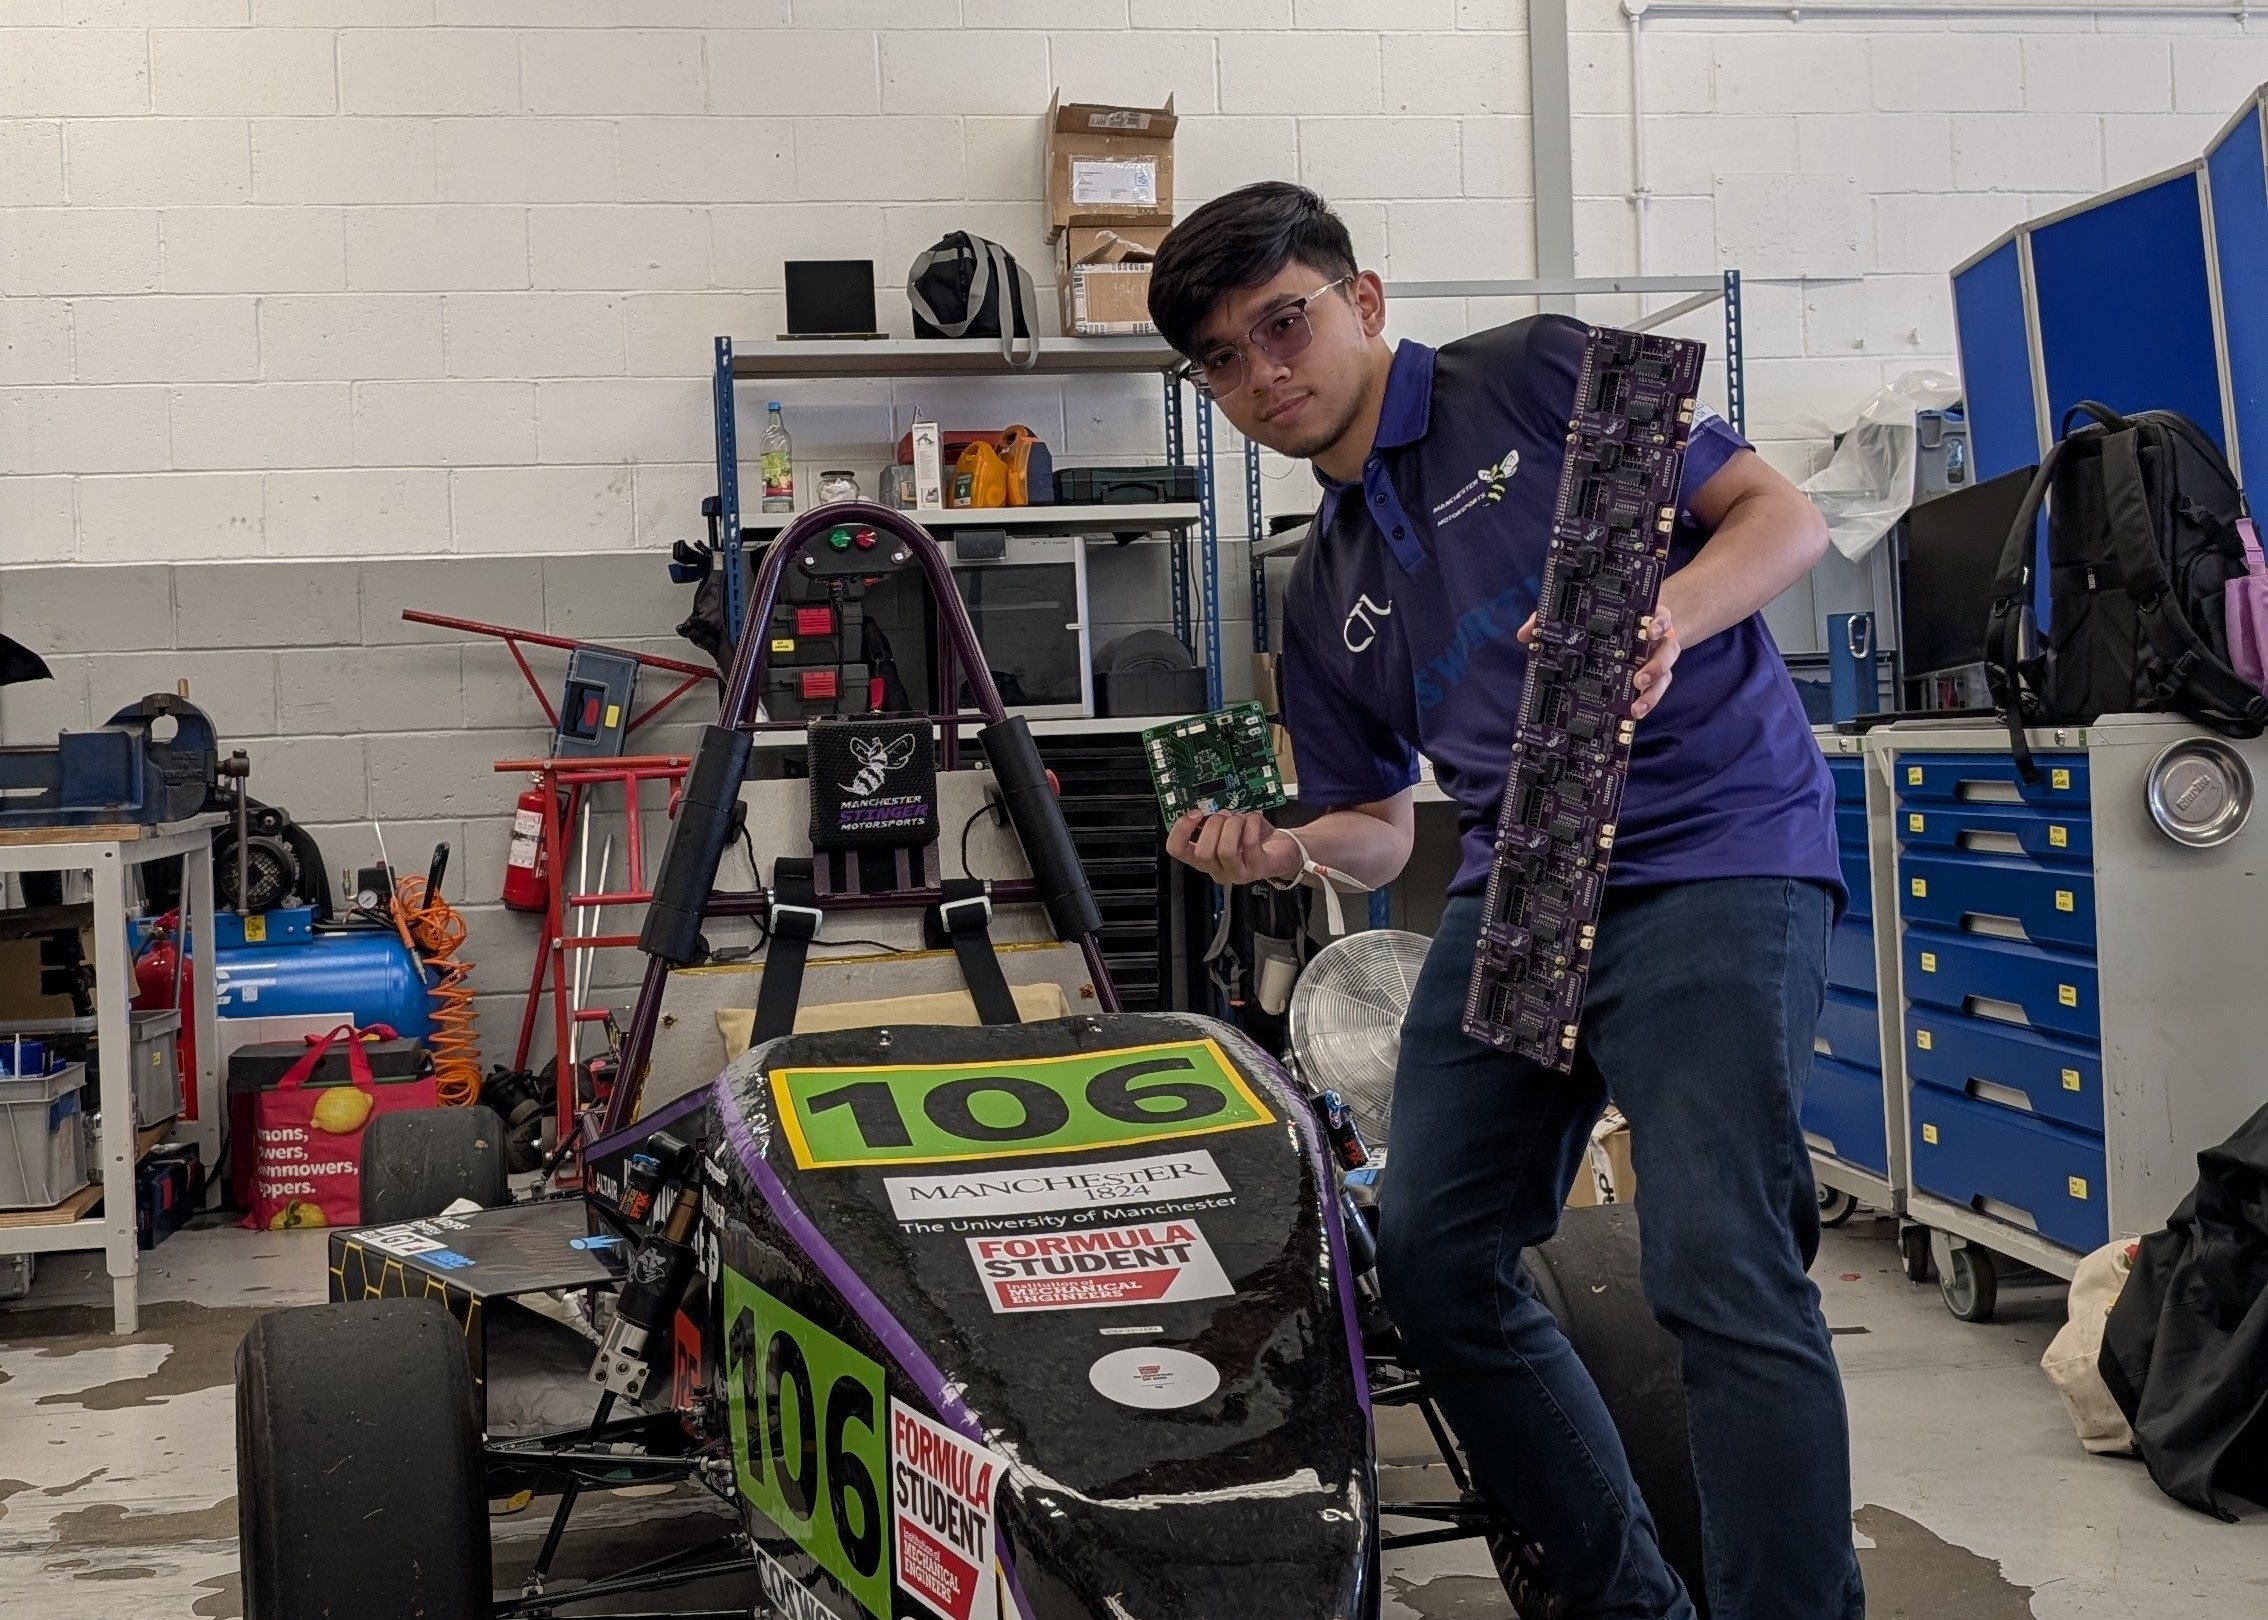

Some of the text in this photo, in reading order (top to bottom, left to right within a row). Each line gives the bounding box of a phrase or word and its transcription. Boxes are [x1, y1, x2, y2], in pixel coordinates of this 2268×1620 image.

[1433, 479, 1479, 514] MANCHESTER
[1437, 492, 1486, 527] MOTORSPORTS
[840, 804, 928, 822] STINGER
[841, 796, 922, 809] MANCHESTER
[841, 818, 925, 830] MOTORSPORTS
[806, 1057, 1227, 1148] 106
[906, 1163, 1208, 1201] MANCHESTER
[1083, 1185, 1151, 1201] 1824
[899, 1196, 1237, 1235] The University of Manchester
[976, 1224, 1198, 1259] FORMULA
[984, 1243, 1192, 1278] STUDENT
[1006, 1279, 1094, 1290] Institution of
[1008, 1281, 1142, 1297] MECHANICAL
[1012, 1289, 1123, 1304] ENGINEERS
[729, 1304, 882, 1578] 106
[895, 1409, 993, 1515] FORMULA
[896, 1461, 986, 1563] STUDENT
[904, 1539, 960, 1594] MECHANICAL
[904, 1556, 952, 1604] ENGINEERS
